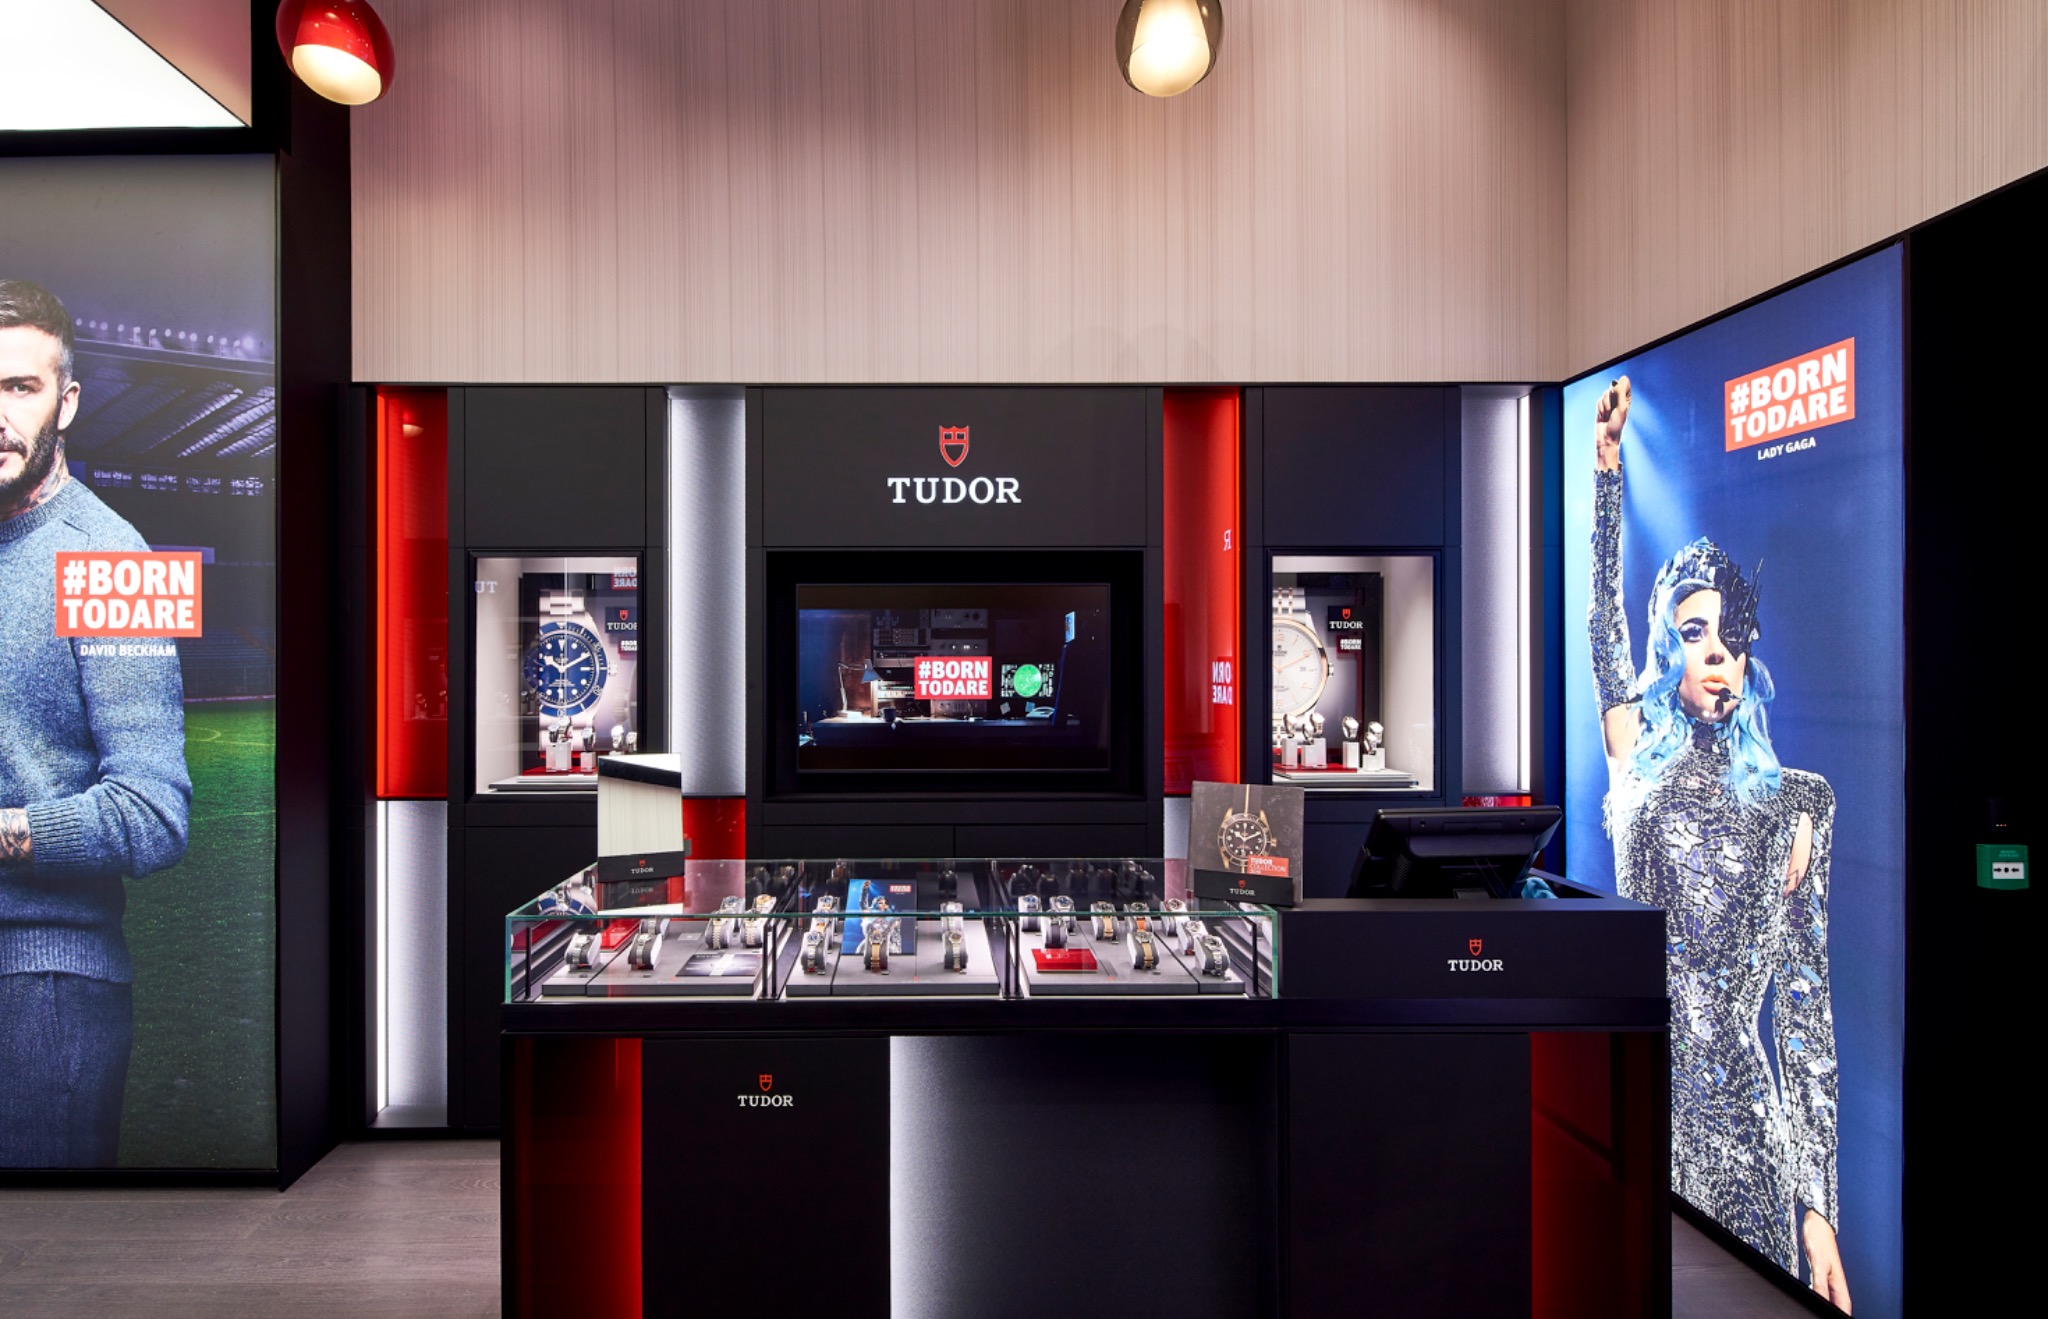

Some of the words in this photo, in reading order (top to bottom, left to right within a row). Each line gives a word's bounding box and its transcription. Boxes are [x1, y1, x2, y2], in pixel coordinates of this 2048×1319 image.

[1730, 348, 1847, 415] #BORN
[1730, 385, 1847, 443] TODARE
[1757, 444, 1784, 460] LADY
[1785, 436, 1817, 454] GAGA
[887, 476, 1022, 504] TUDOR
[63, 559, 195, 596] #BORN
[63, 598, 195, 629] TODARE
[1329, 620, 1364, 629] TUDOR
[80, 644, 116, 657] DAVID
[119, 644, 177, 657] BECKHAM
[918, 660, 989, 679] #BORN
[918, 680, 989, 696] TODARE
[1229, 888, 1256, 896] TUDOR
[1447, 959, 1504, 972] TUDOR
[737, 1094, 794, 1107] TUDOR
